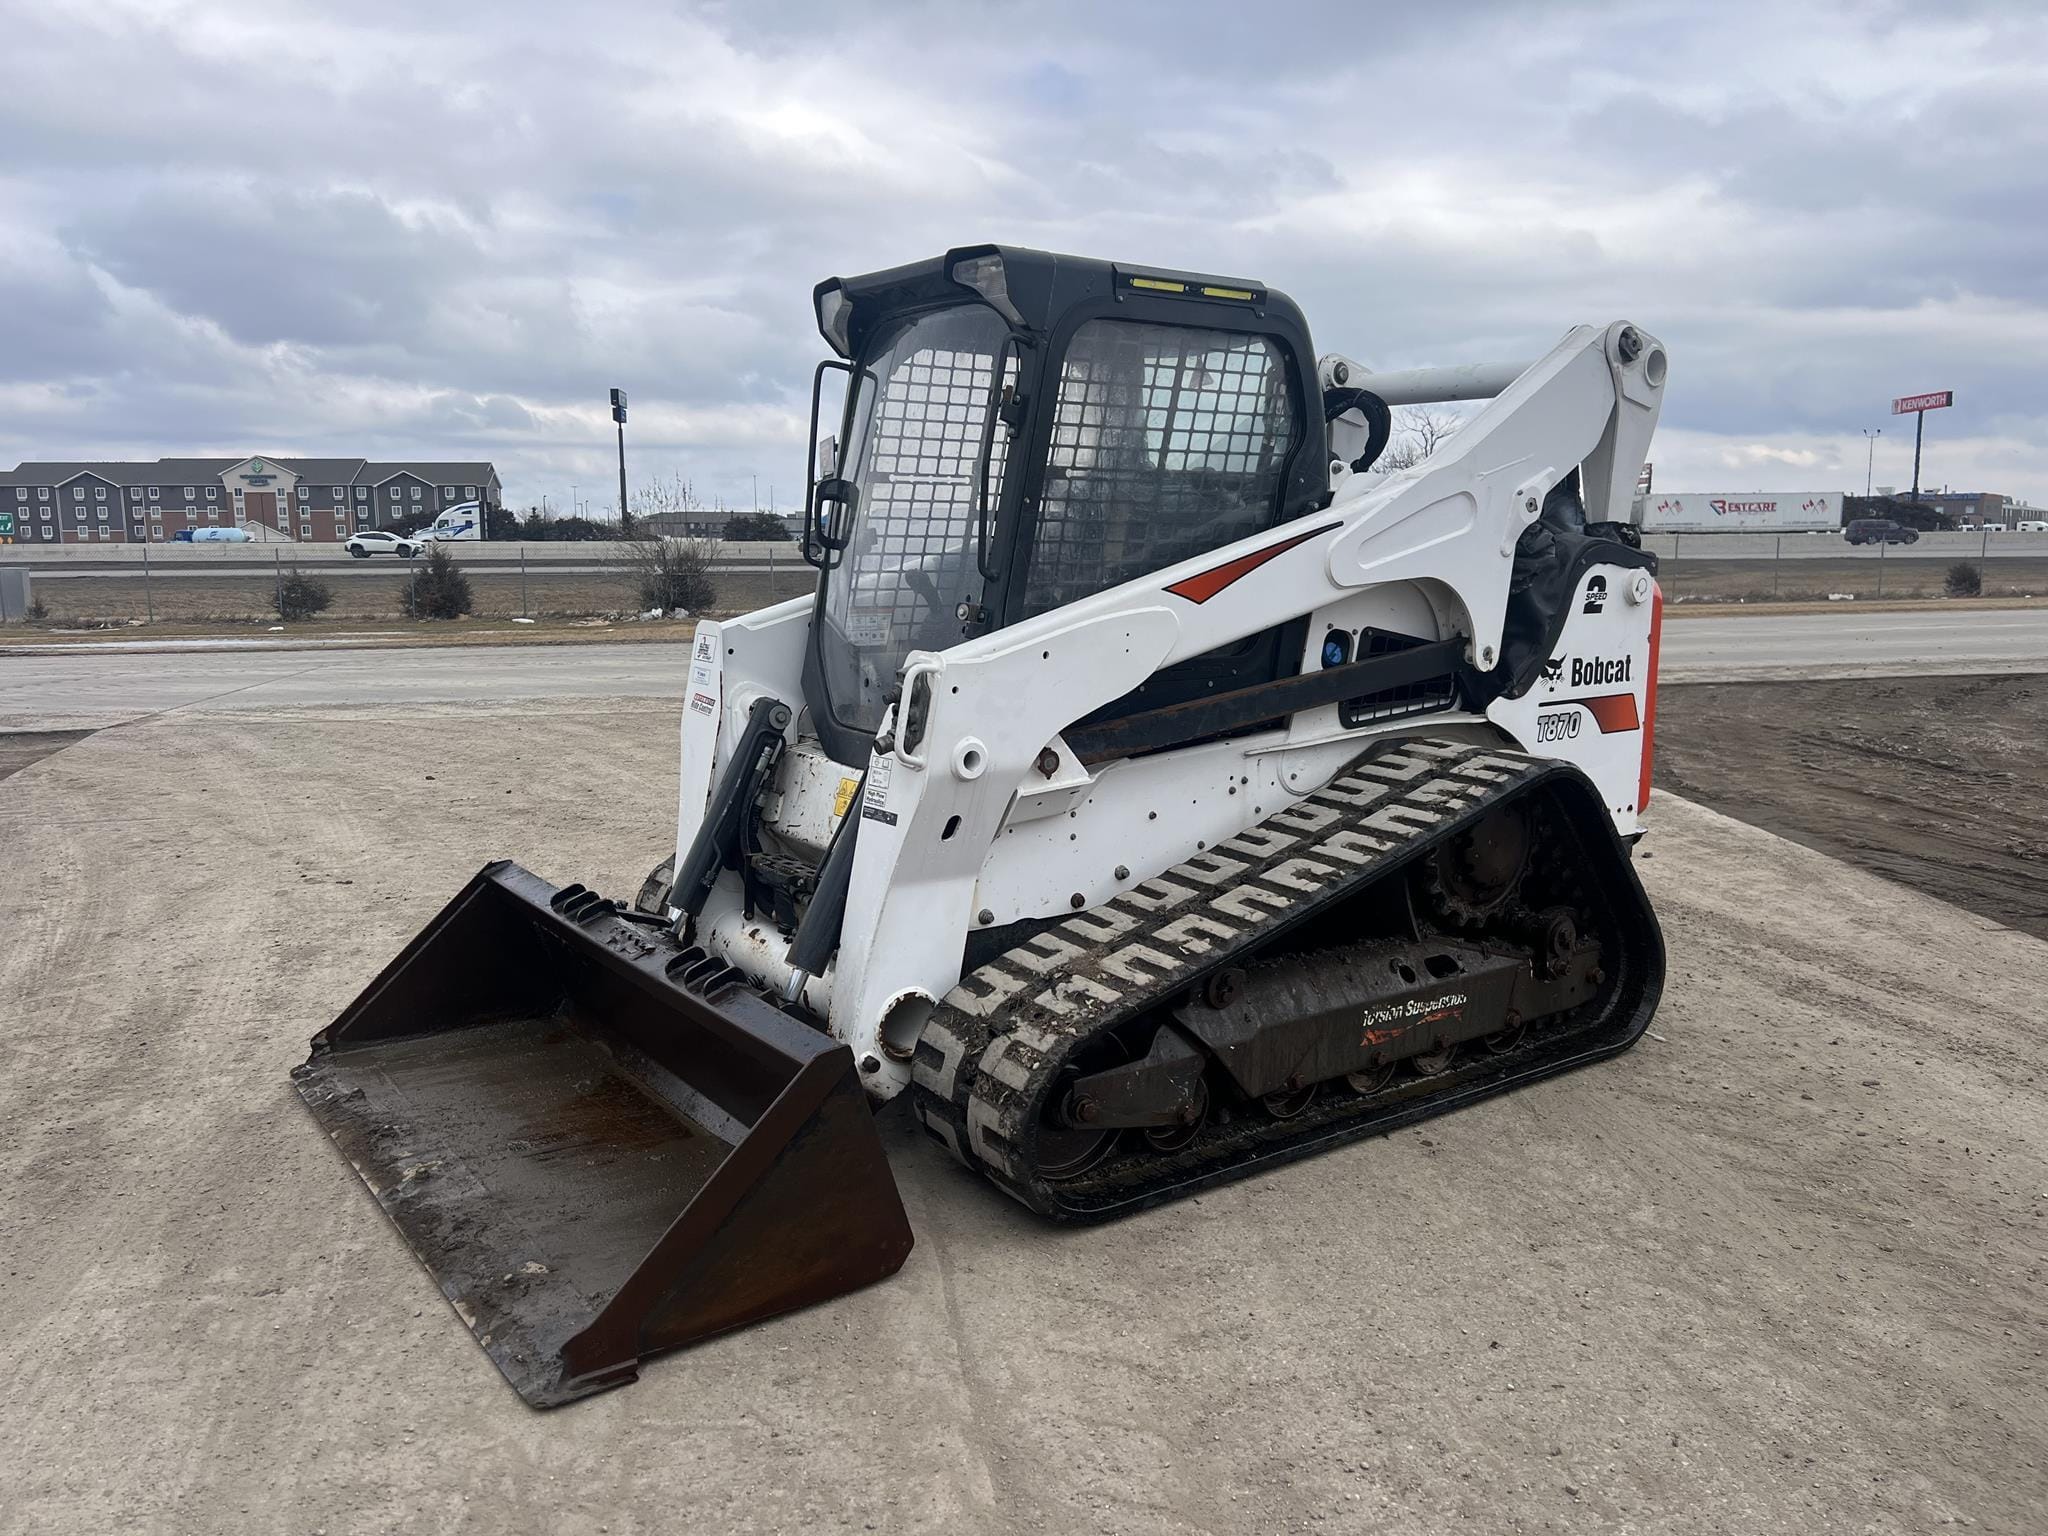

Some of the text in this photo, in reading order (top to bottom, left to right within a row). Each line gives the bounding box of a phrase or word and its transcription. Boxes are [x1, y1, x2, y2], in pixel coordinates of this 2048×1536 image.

[1902, 394, 1946, 410] KENWORTH
[1583, 575, 1607, 614] 2
[1571, 655, 1631, 687] Bobcat
[1537, 711, 1582, 743] T870
